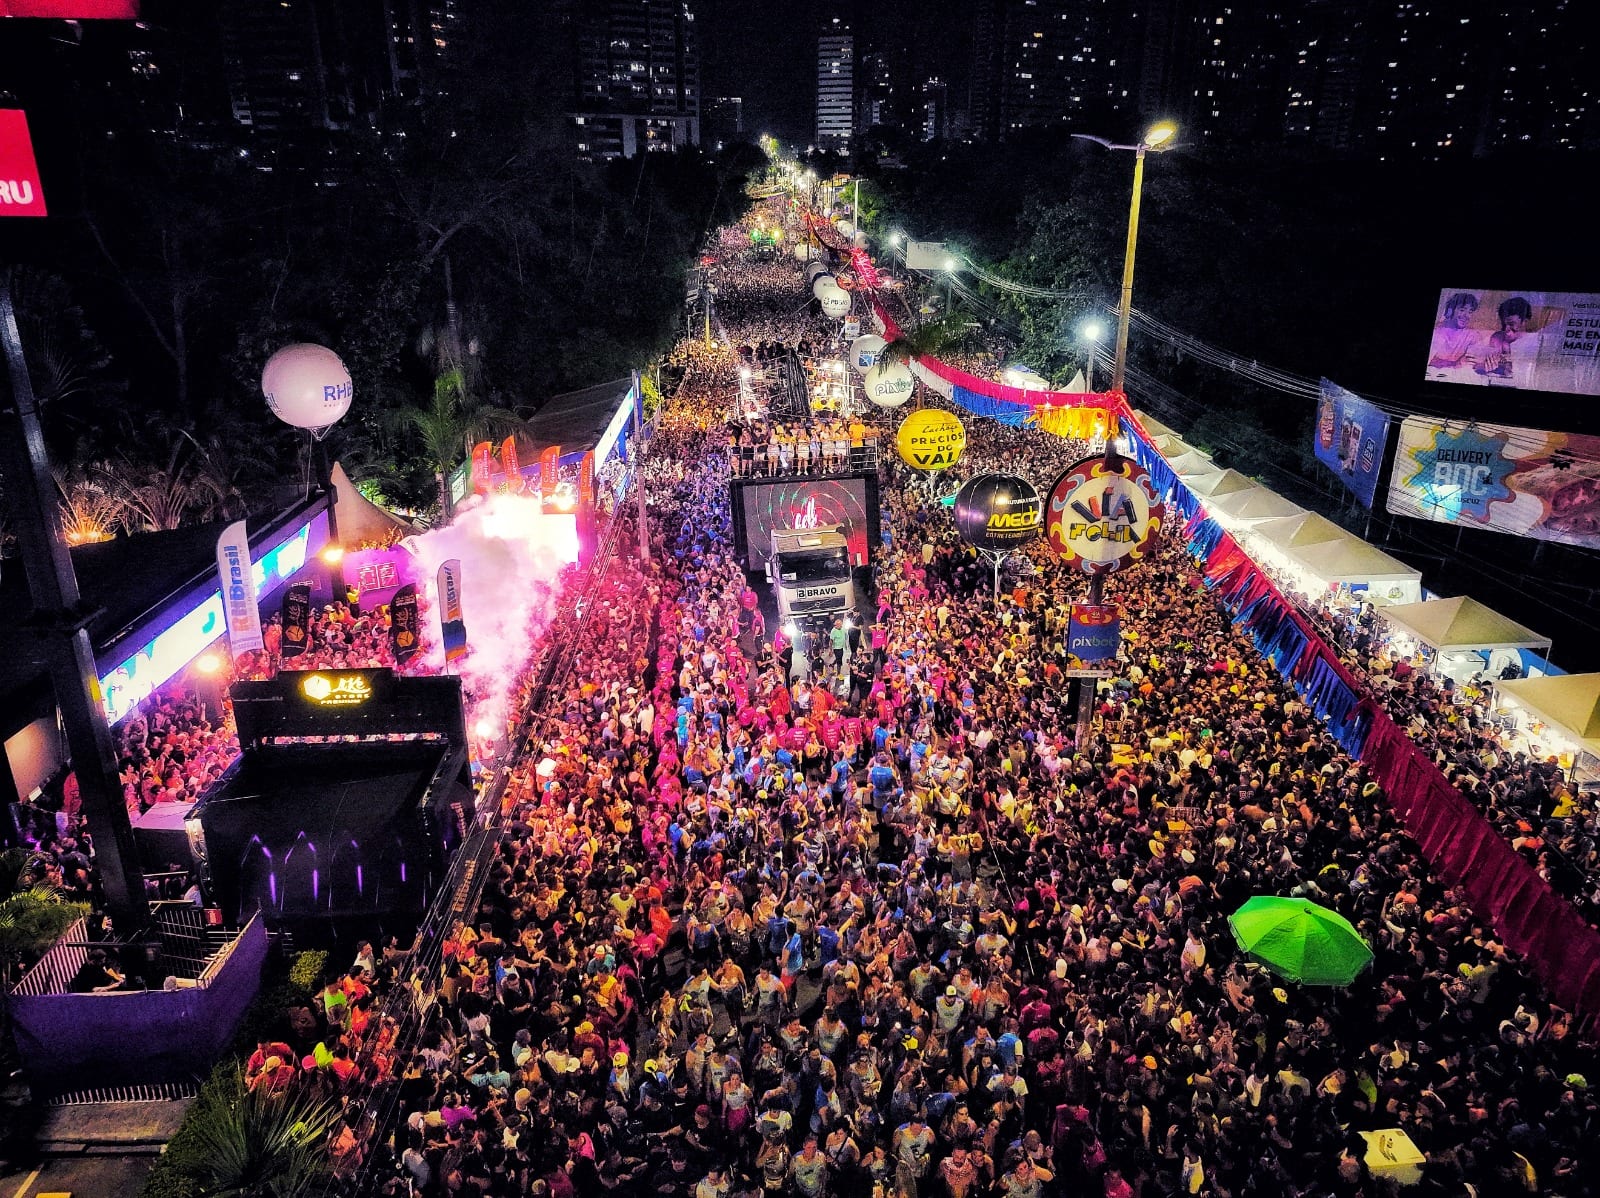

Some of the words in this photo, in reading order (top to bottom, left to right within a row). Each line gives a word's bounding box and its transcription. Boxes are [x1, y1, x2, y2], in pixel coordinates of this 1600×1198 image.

[1567, 318, 1600, 328] ESTU
[1565, 329, 1583, 339] DE
[1562, 341, 1594, 351] MAIS
[911, 431, 965, 445] PRECIOS
[1437, 450, 1493, 465] DELIVERY
[807, 587, 837, 597] BRAVO
